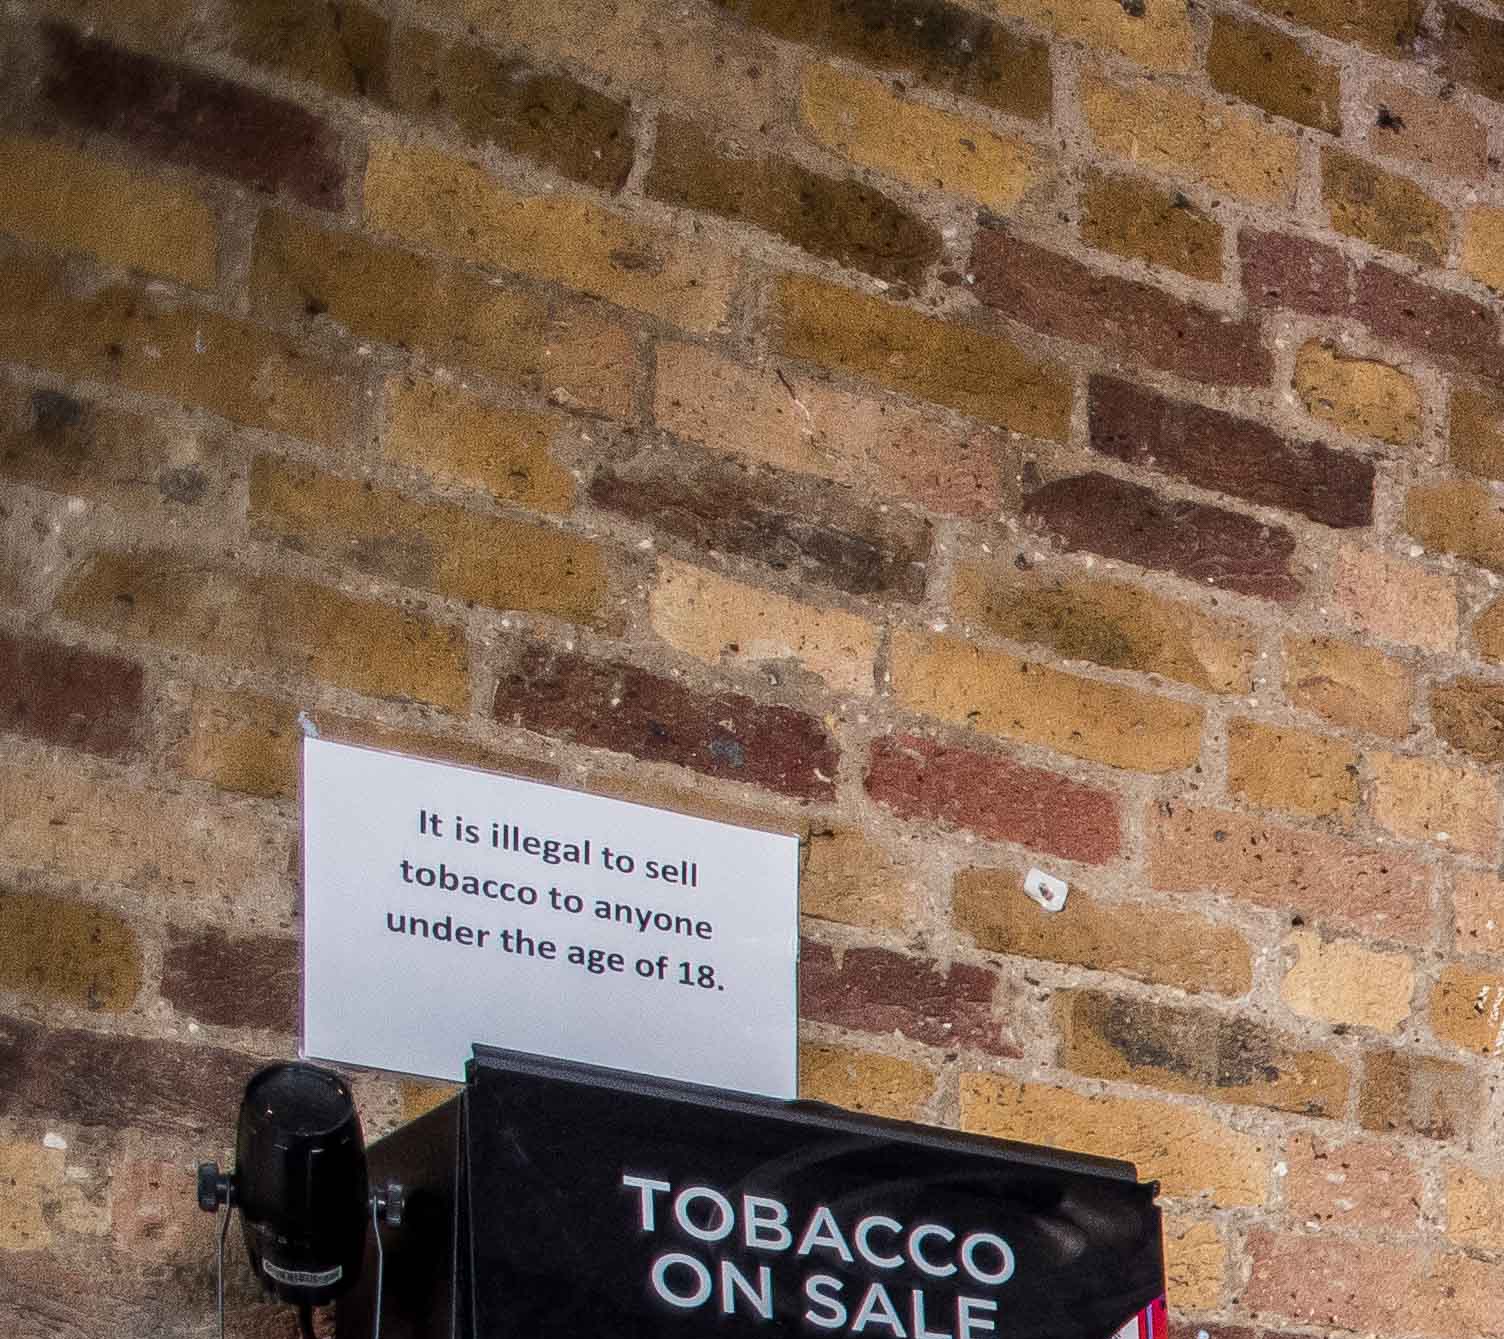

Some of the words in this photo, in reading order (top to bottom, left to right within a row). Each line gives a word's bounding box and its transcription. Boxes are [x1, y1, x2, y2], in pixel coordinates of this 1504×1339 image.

[417, 809, 443, 838] It
[454, 815, 480, 844] is
[491, 823, 591, 866] illegal
[601, 846, 635, 875] to
[646, 860, 698, 888] sell
[401, 858, 538, 906] tobacco
[549, 886, 584, 914] to
[594, 899, 714, 941] anyone
[386, 911, 490, 949] under
[499, 928, 557, 961] the
[567, 943, 625, 975] age
[635, 956, 669, 982] of
[678, 962, 726, 992] 18.
[622, 1174, 1016, 1285] TOBACCO
[651, 1252, 774, 1321] ON
